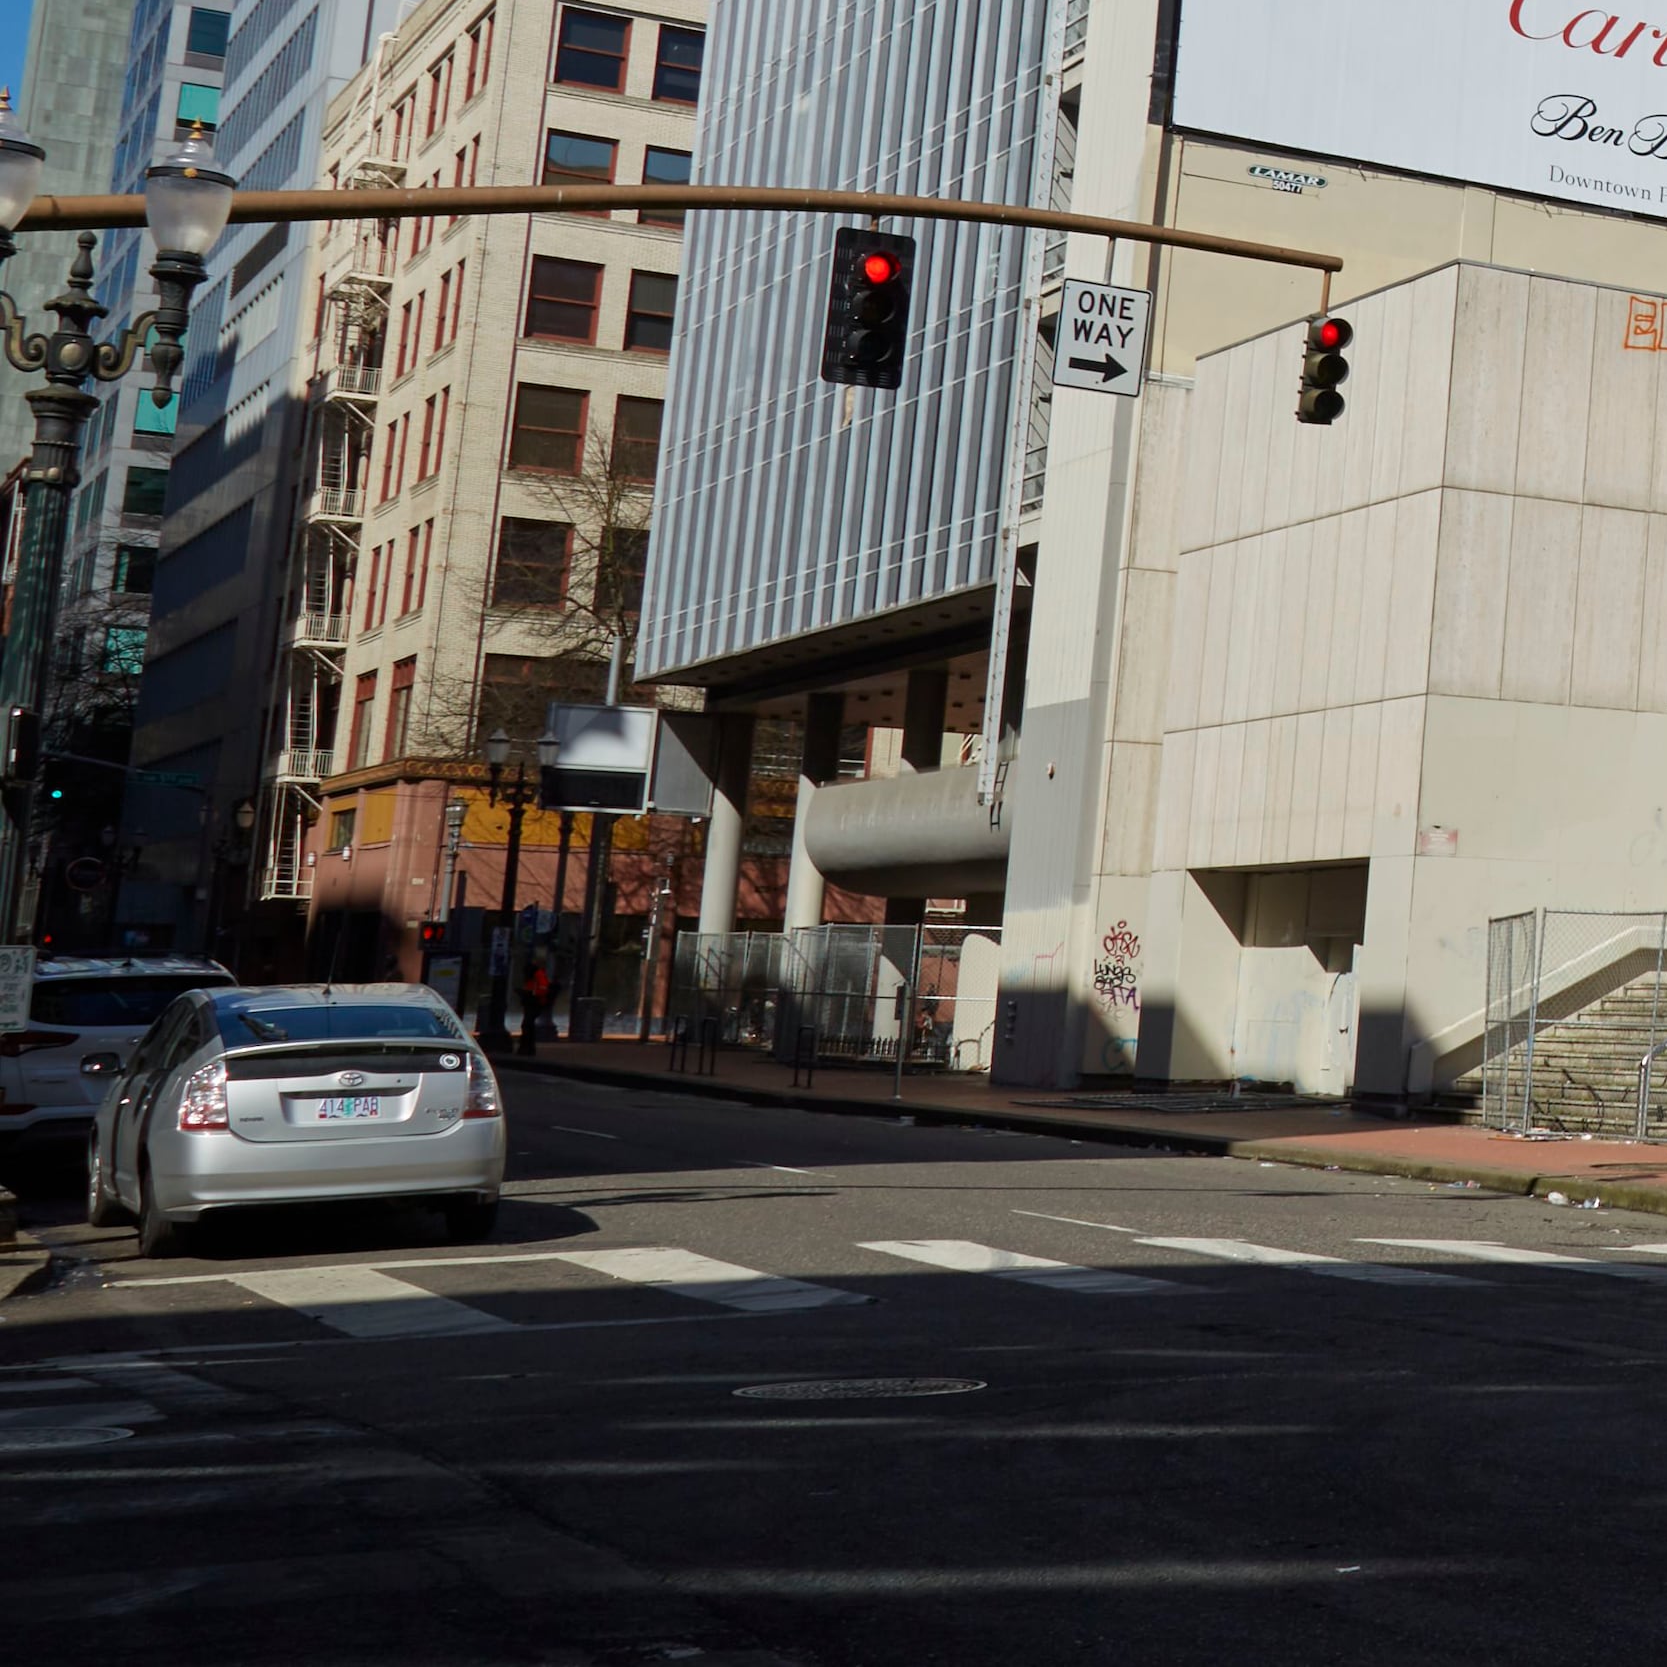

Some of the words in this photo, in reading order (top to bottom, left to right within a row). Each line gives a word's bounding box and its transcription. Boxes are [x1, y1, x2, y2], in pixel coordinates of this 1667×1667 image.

[1531, 94, 1624, 146] Ben
[1253, 167, 1319, 186] LAMAR
[1549, 164, 1652, 201] Downtown
[1078, 290, 1135, 321] ONE
[1073, 318, 1134, 349] WAY
